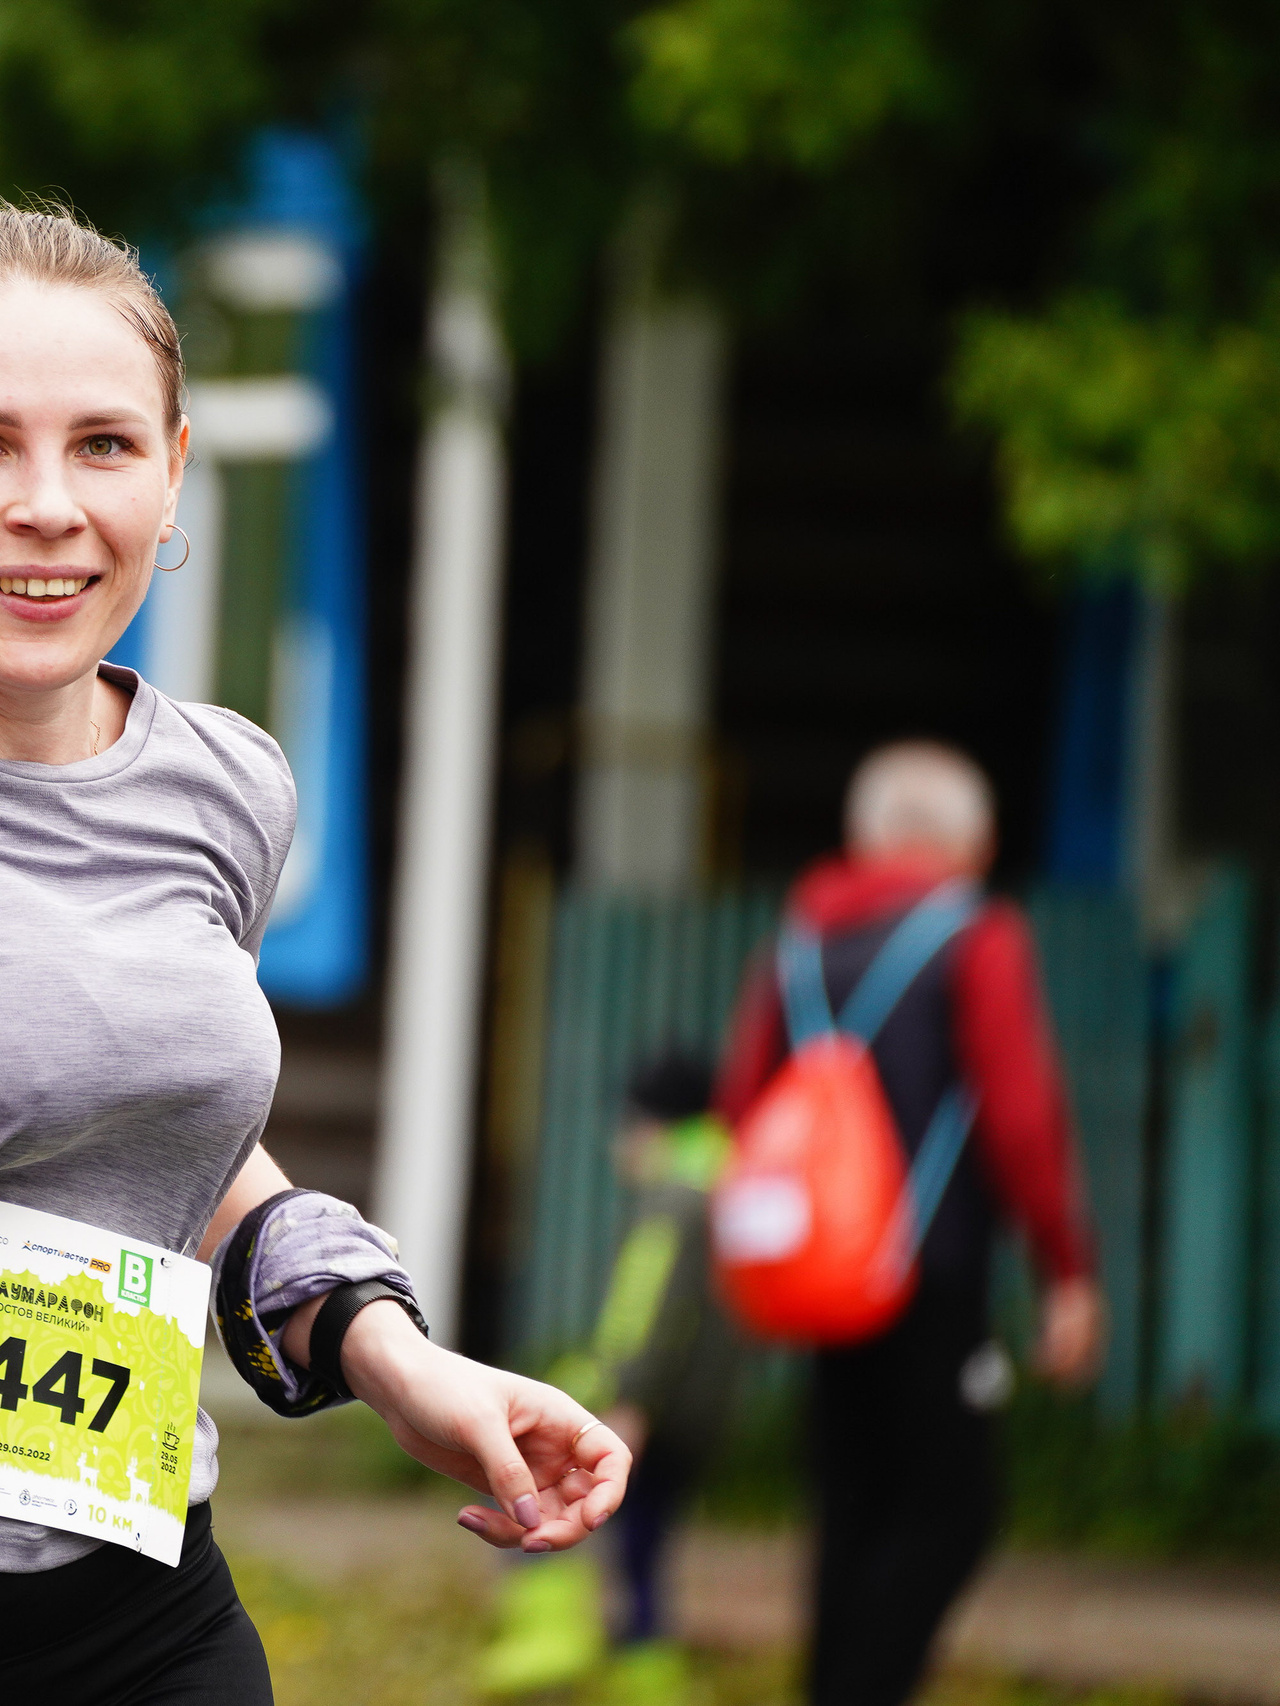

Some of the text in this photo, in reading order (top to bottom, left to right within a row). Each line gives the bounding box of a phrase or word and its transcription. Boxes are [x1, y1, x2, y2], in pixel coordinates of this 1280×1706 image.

[89, 1259, 111, 1272] PRO
[35, 1311, 90, 1332] ВЕЛИКИЙ»
[160, 1451, 178, 1464] 29.05
[160, 1462, 176, 1475] 2022
[88, 1504, 133, 1533] 10 КМ
